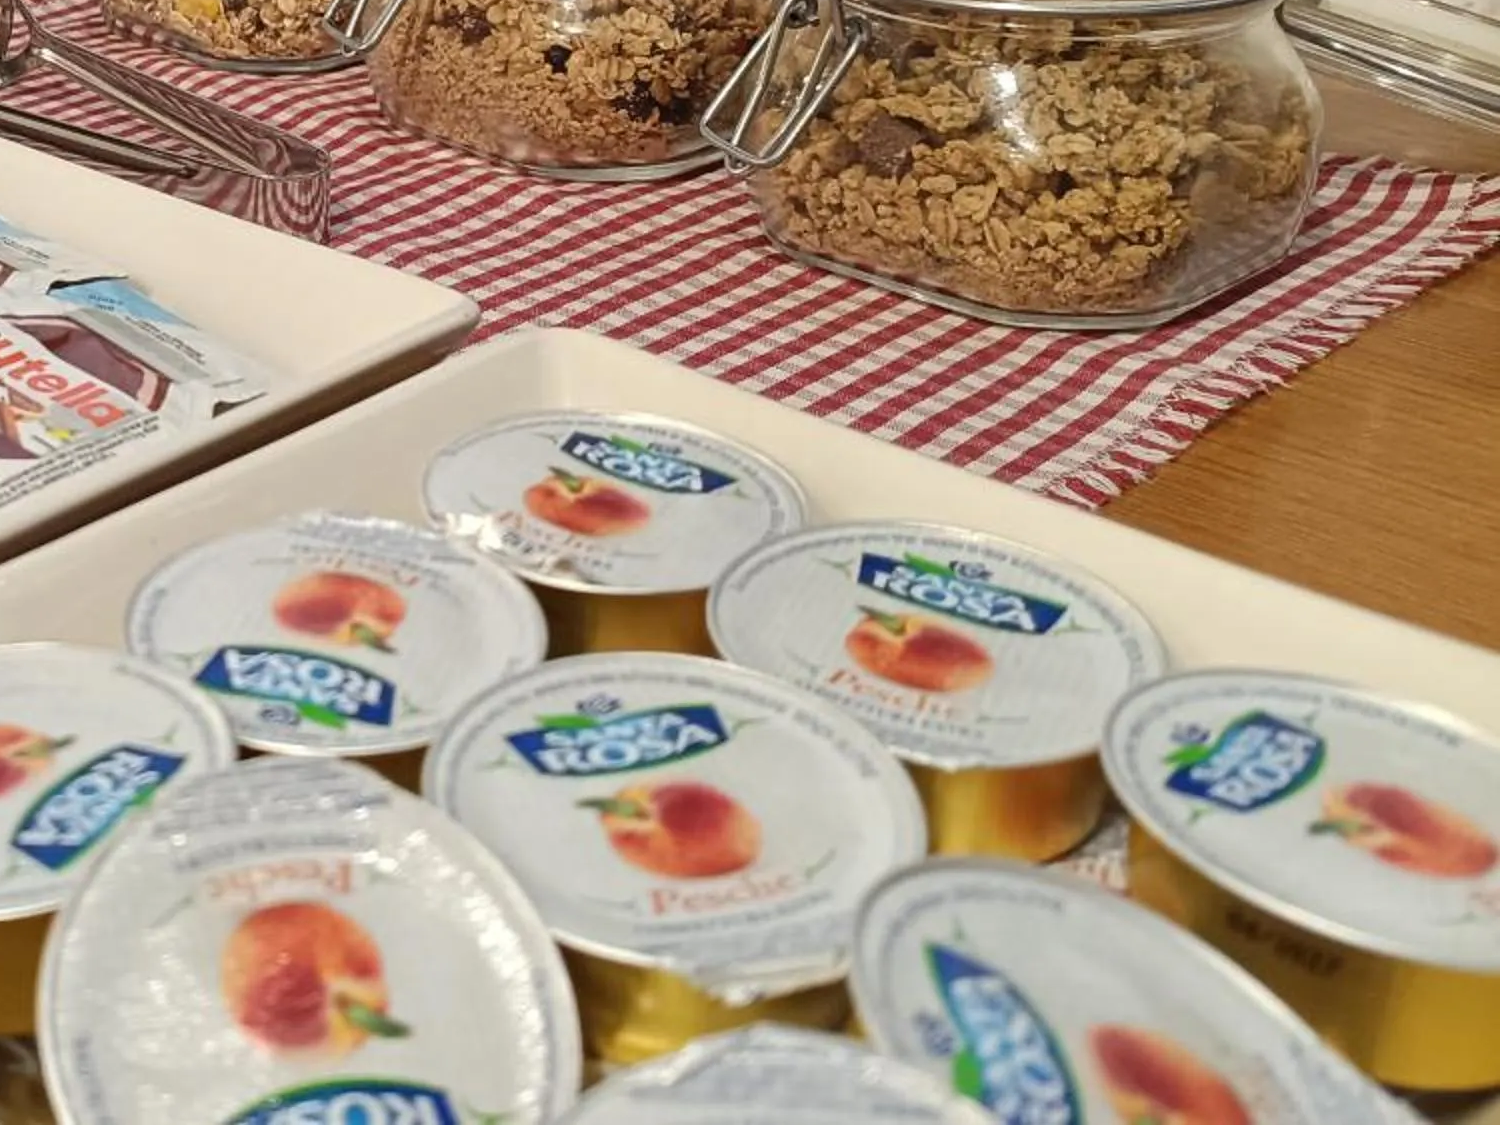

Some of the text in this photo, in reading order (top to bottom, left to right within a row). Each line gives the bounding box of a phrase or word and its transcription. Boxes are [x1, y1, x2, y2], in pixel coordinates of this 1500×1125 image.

[572, 441, 703, 492] ROSA
[873, 570, 1036, 632] ROSA
[224, 648, 383, 705] ROSA
[534, 723, 719, 773] ROSA
[544, 712, 688, 748] SANTA
[1207, 729, 1317, 806] ROSA
[18, 750, 149, 846] ROSA
[650, 872, 793, 916] Pesche
